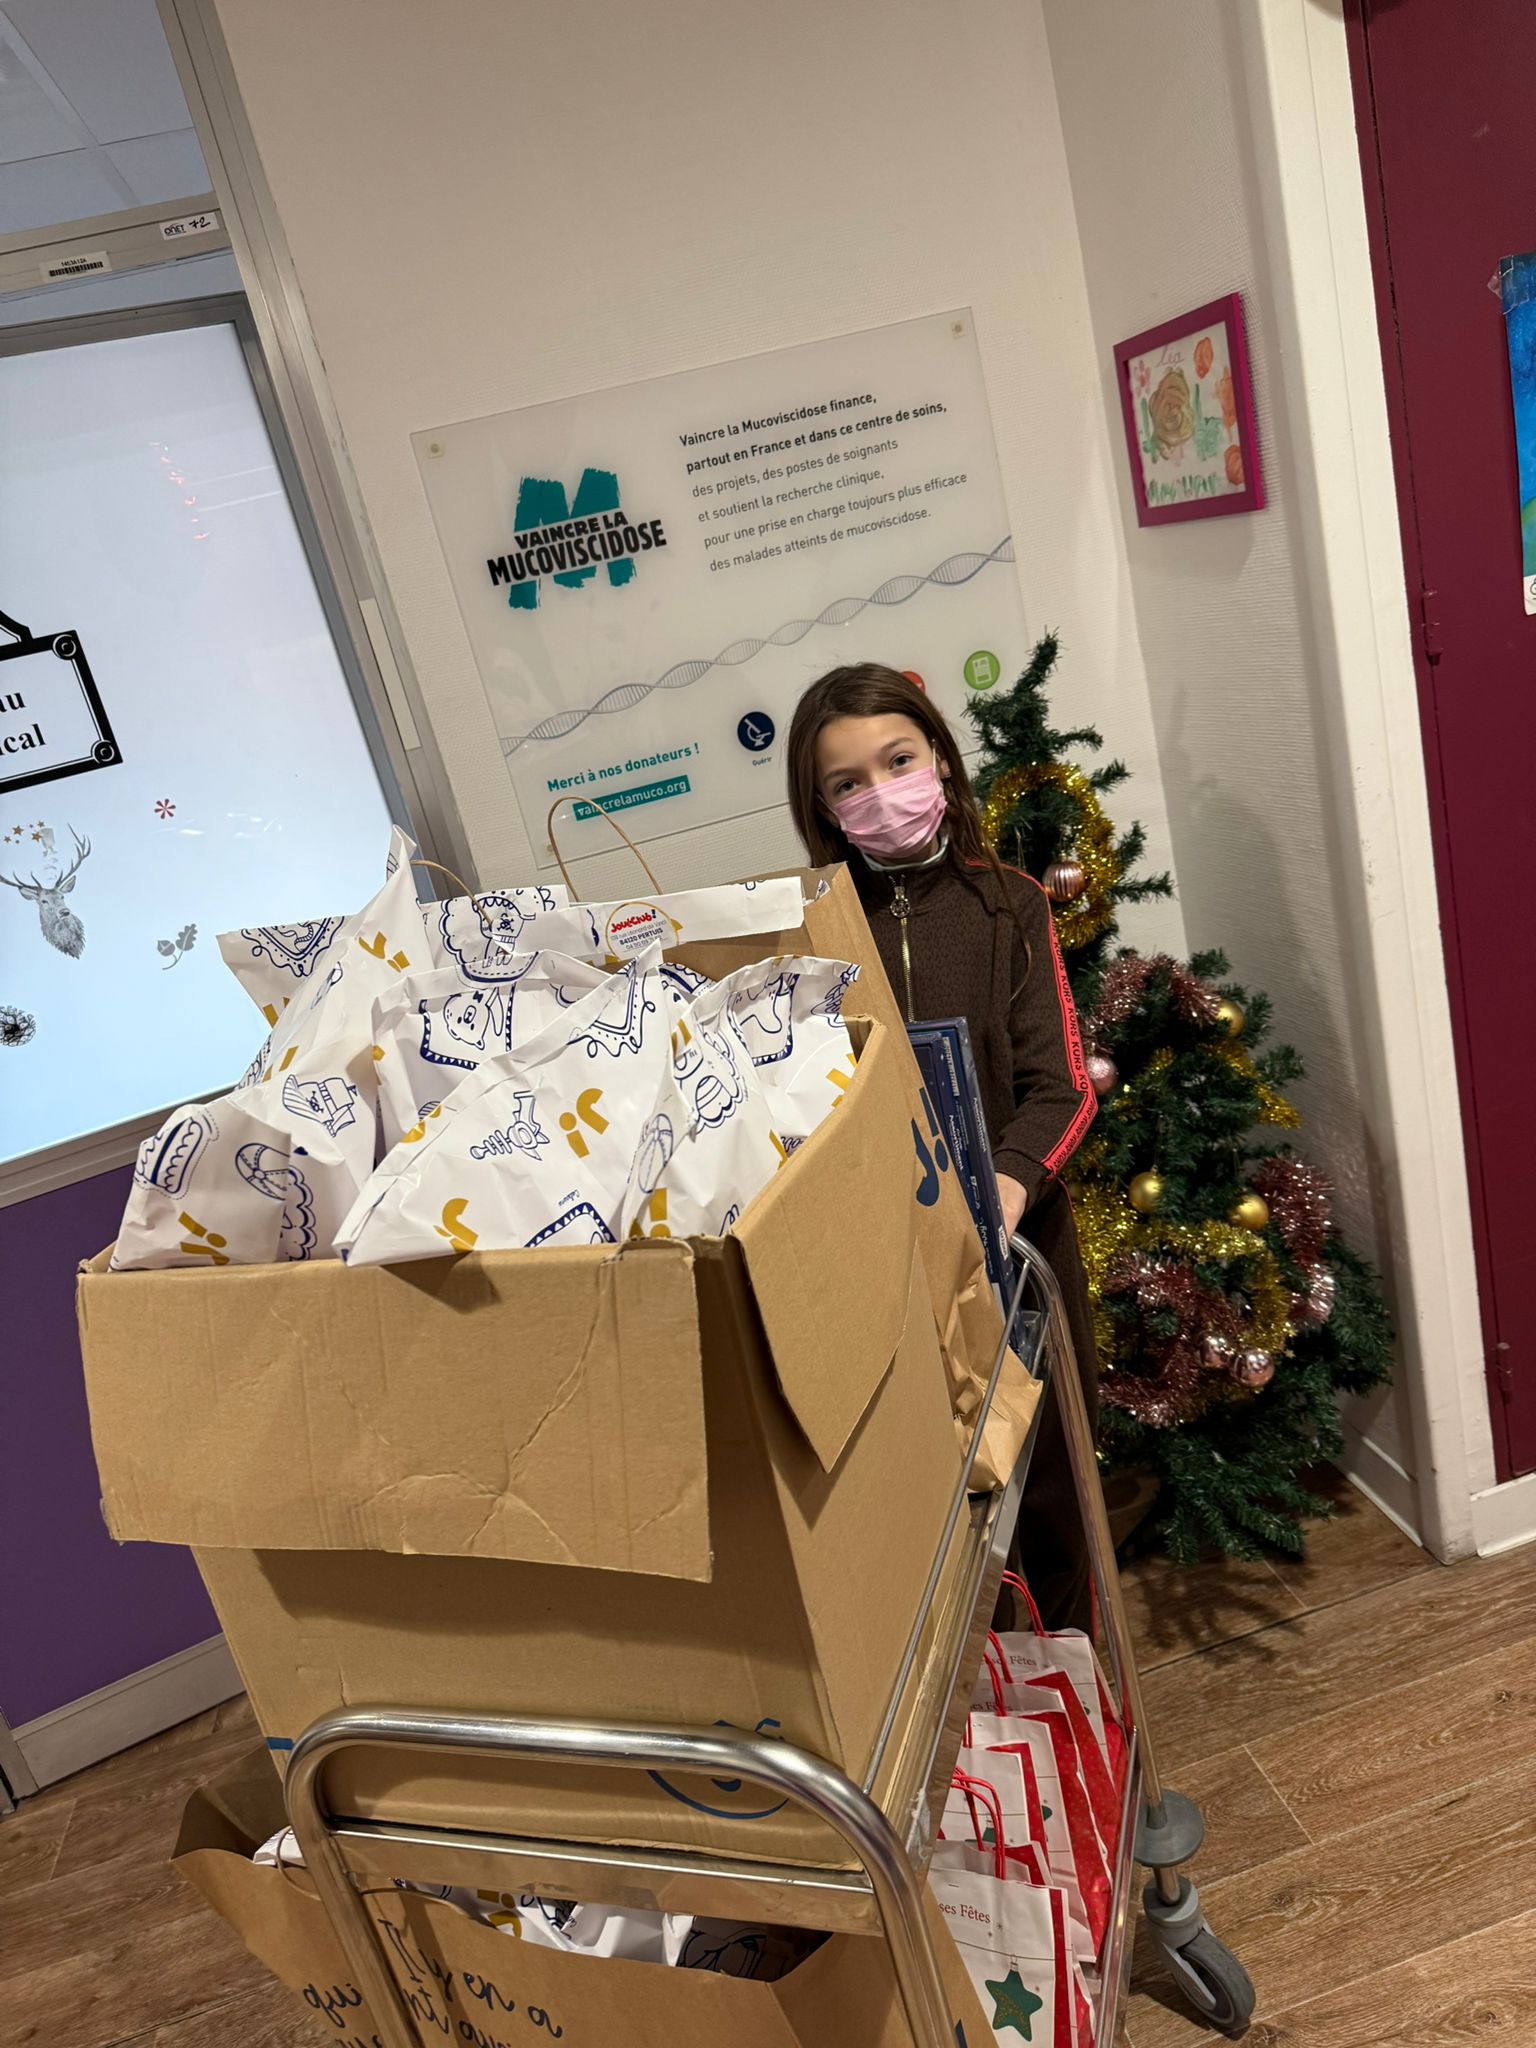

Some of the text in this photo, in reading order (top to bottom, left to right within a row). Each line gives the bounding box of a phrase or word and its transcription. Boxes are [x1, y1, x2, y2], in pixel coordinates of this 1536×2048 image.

[679, 393, 877, 447] Vaincre la Mucoviscidose finance,
[686, 402, 947, 475] partout en France et dans ce centre de soins,
[692, 439, 899, 498] des projets, des postes de soignants
[698, 470, 884, 522] et soutient la recherche clinique,
[704, 474, 968, 549] pour une prise en charge toujours plus efficace
[486, 519, 668, 586] MUCOVISCIDOSE
[514, 511, 629, 550] VAINCRE LA
[710, 508, 932, 572] des malades atteints de mucoviscidose.
[547, 742, 700, 792] Merci à nos donateurs !
[638, 927, 663, 940] PERTUIS
[1061, 975, 1073, 1004] KORS
[1068, 1006, 1078, 1037] KORS
[1072, 1041, 1082, 1071] KORS
[1010, 1655, 1037, 1666] Fêtes
[938, 1902, 991, 1924] ses Fêtes
[303, 1983, 362, 2028] qui
[402, 1986, 449, 2035] nt
[463, 1972, 515, 2012] en
[528, 2005, 563, 2038] a
